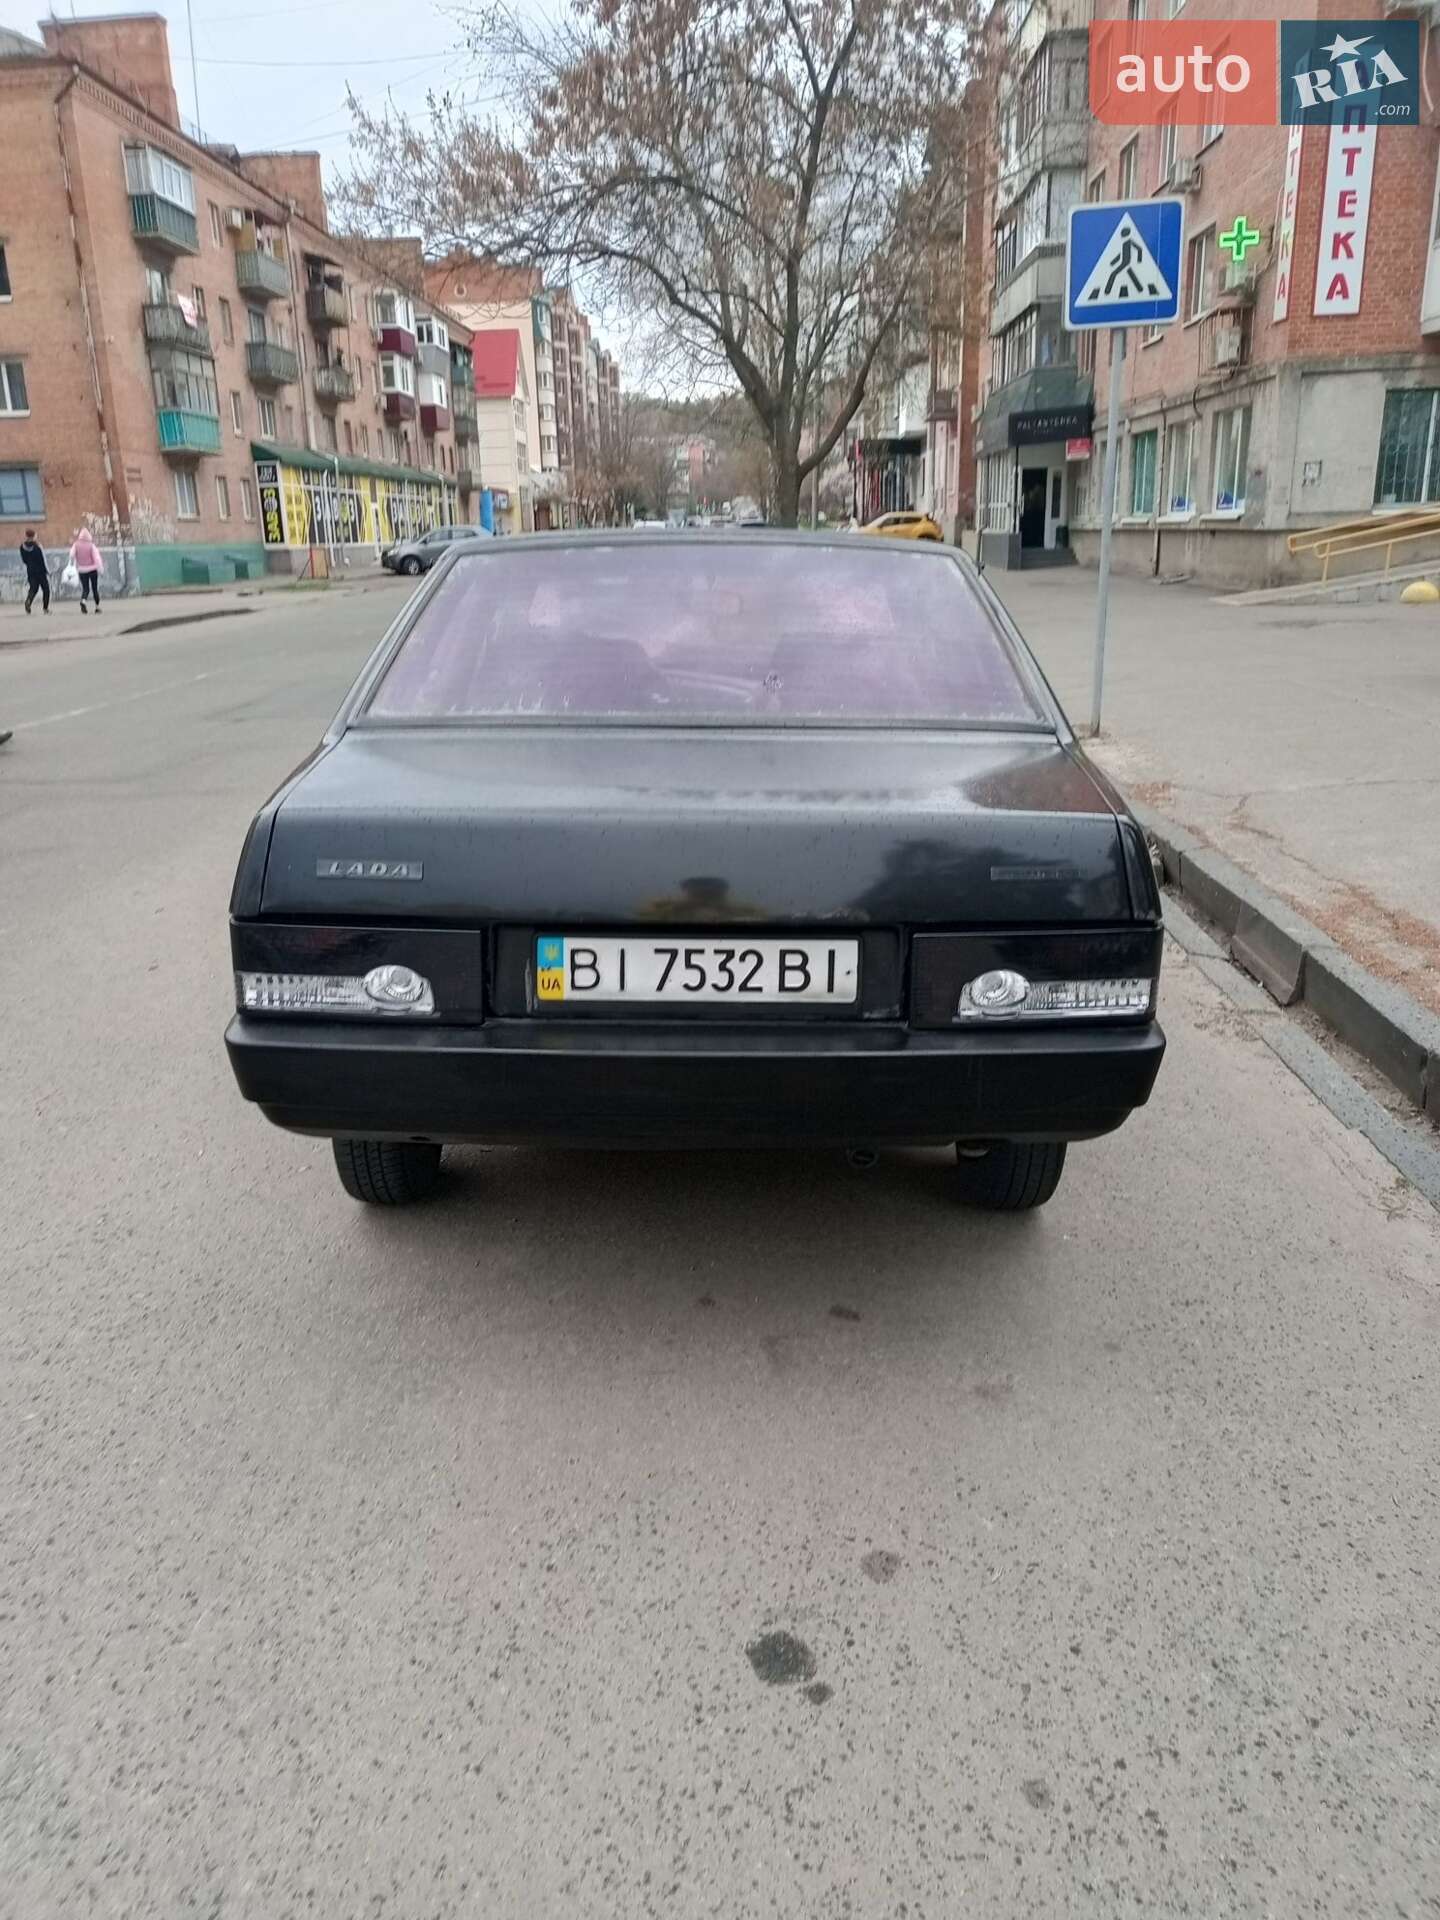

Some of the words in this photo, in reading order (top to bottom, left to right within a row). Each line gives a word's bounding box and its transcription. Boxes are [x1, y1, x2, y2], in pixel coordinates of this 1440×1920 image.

[328, 862, 409, 877] LADA
[569, 948, 626, 992] BI
[653, 948, 764, 993] 7532
[777, 948, 836, 994] BI
[541, 978, 561, 991] UA
